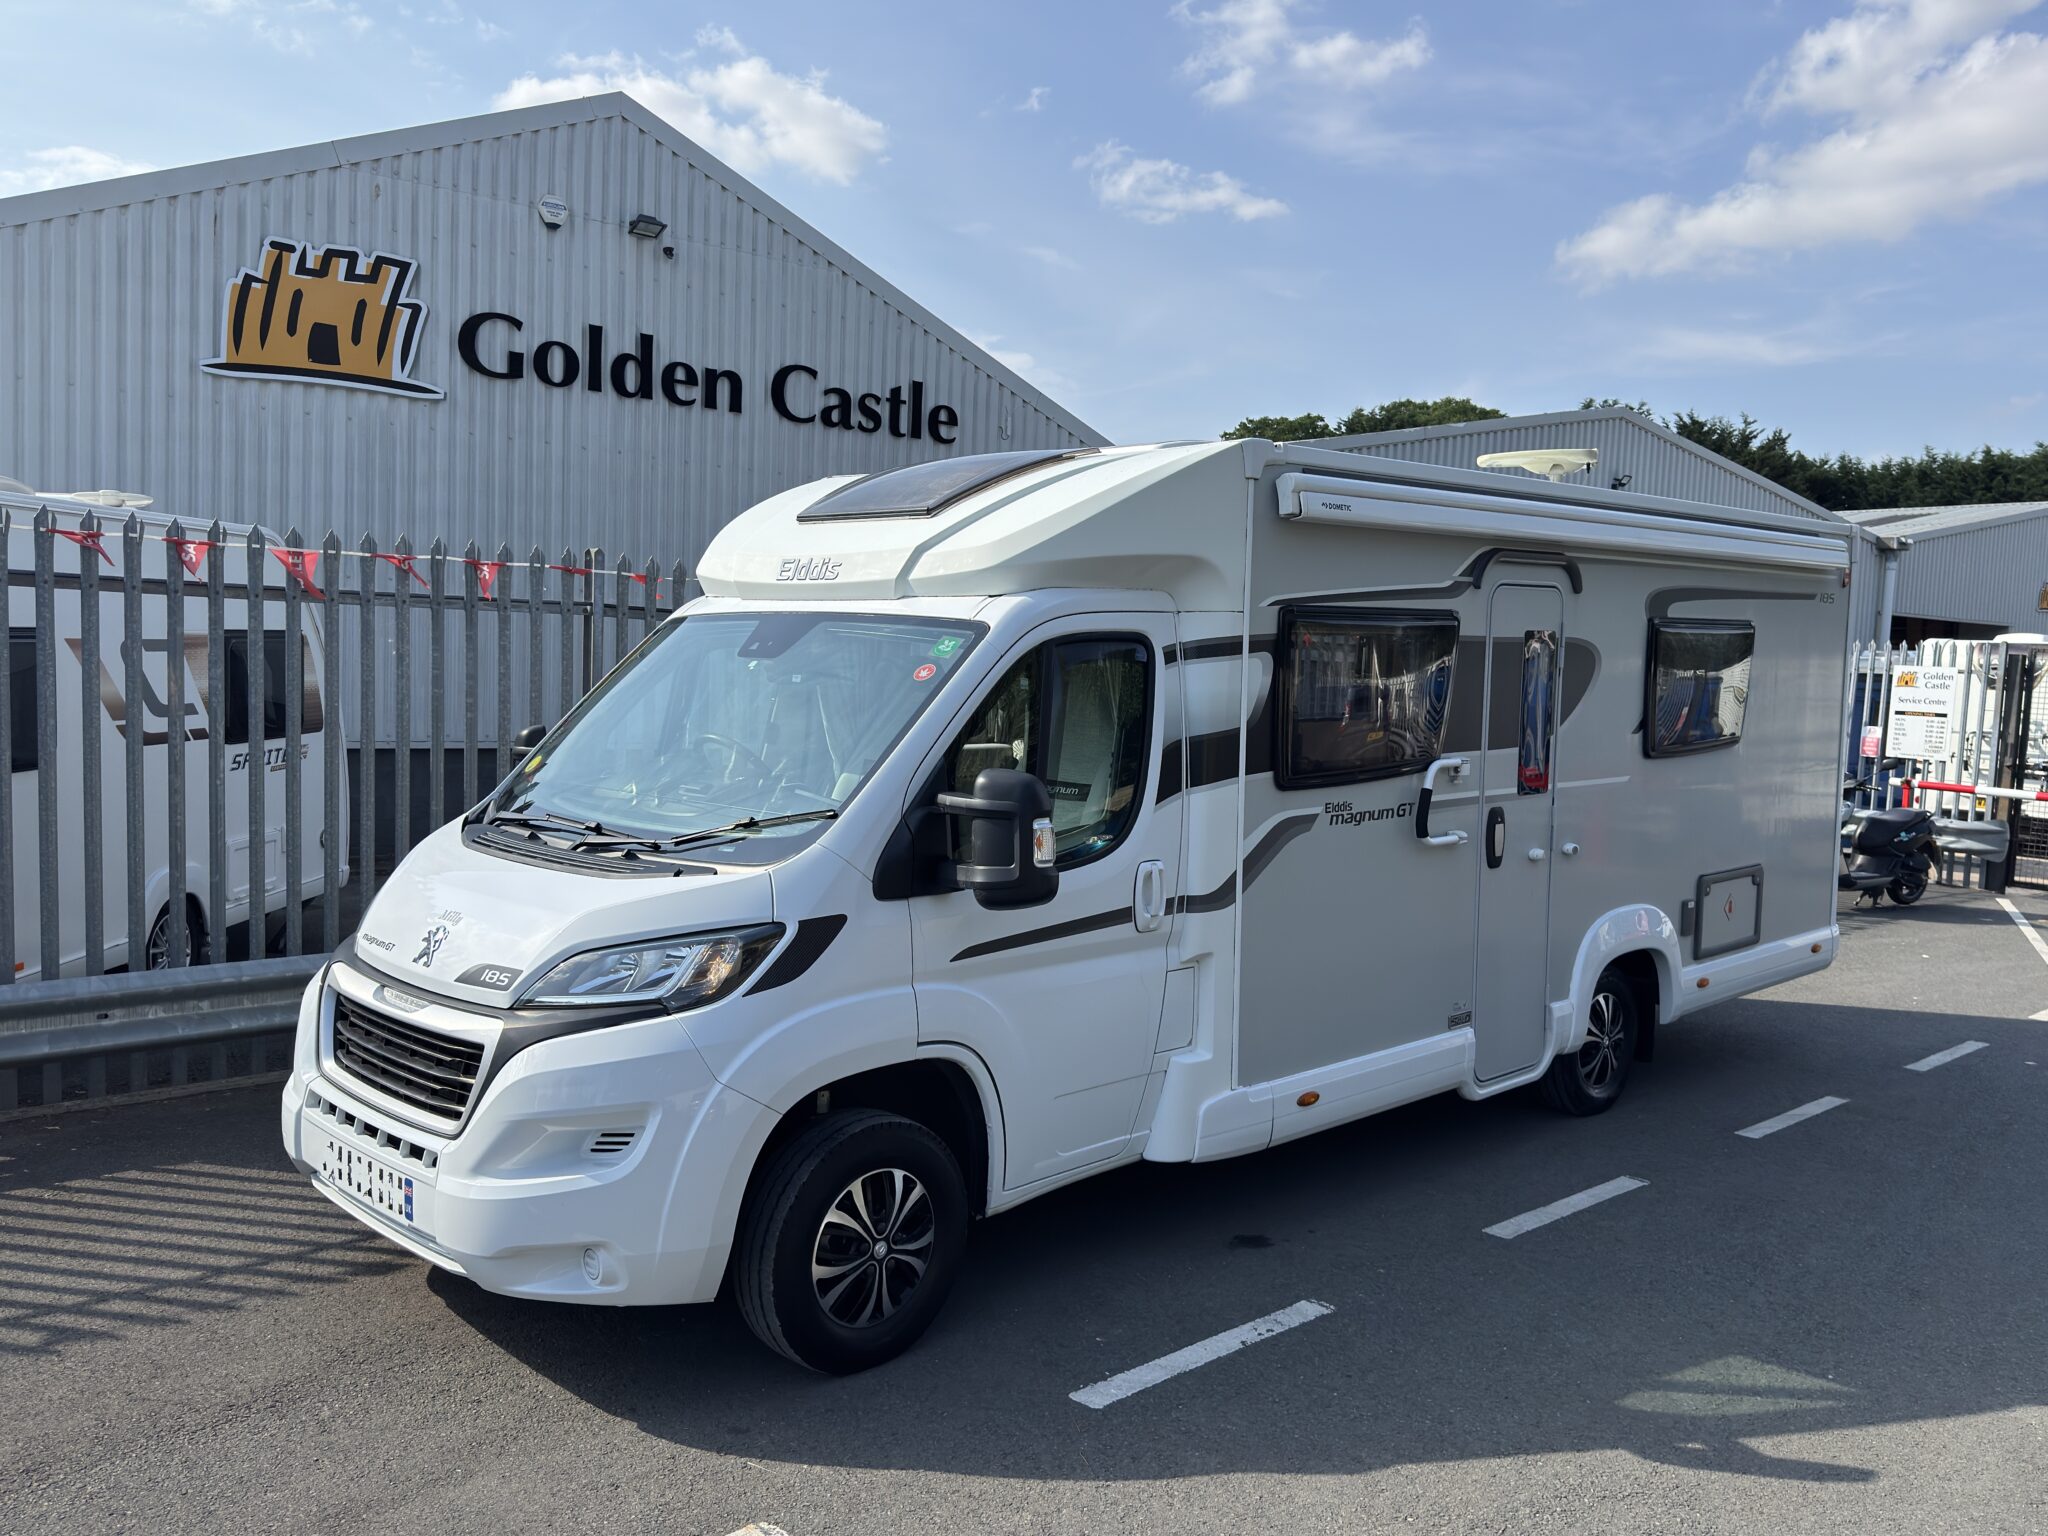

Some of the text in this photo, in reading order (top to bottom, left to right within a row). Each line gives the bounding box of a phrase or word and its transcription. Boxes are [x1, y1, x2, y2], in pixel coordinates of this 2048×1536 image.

[458, 312, 958, 444] Golden Castle
[1329, 502, 1351, 511] DOMETIC
[776, 558, 842, 581] Elddis
[1923, 672, 1954, 680] Golden
[1925, 681, 1951, 689] Castle
[1923, 697, 1947, 705] Centre
[1325, 801, 1353, 813] Elddis
[1329, 808, 1395, 826] magnum
